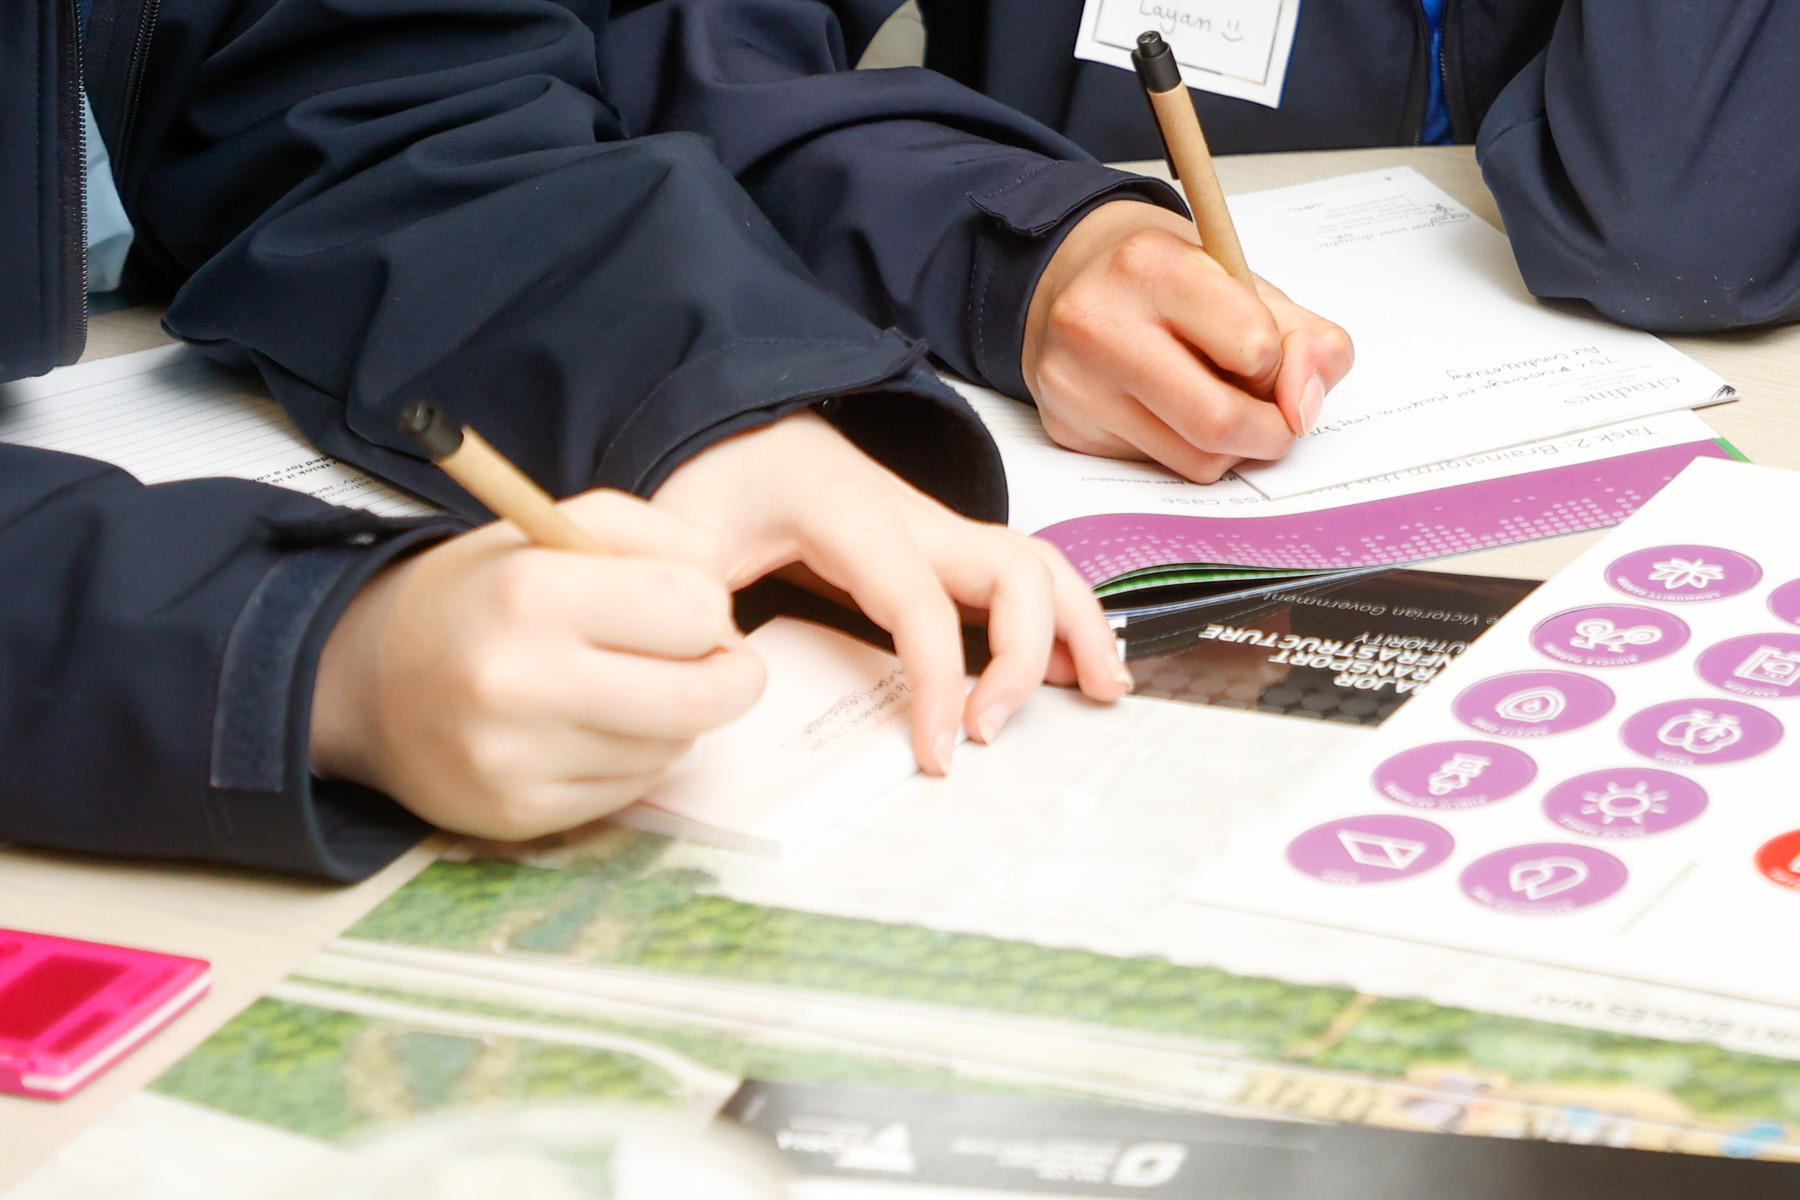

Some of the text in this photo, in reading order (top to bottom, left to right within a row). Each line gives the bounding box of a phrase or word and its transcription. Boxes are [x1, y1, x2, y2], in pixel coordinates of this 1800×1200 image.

[1598, 422, 1658, 448] Task
[286, 463, 304, 473] for
[298, 463, 331, 476] think
[1406, 441, 1559, 480] Brainstorm
[1262, 590, 1386, 618] Government
[1649, 590, 1721, 604] COMMUNITY
[1392, 606, 1480, 627] Victorian
[1268, 649, 1440, 683] RANSPORT
